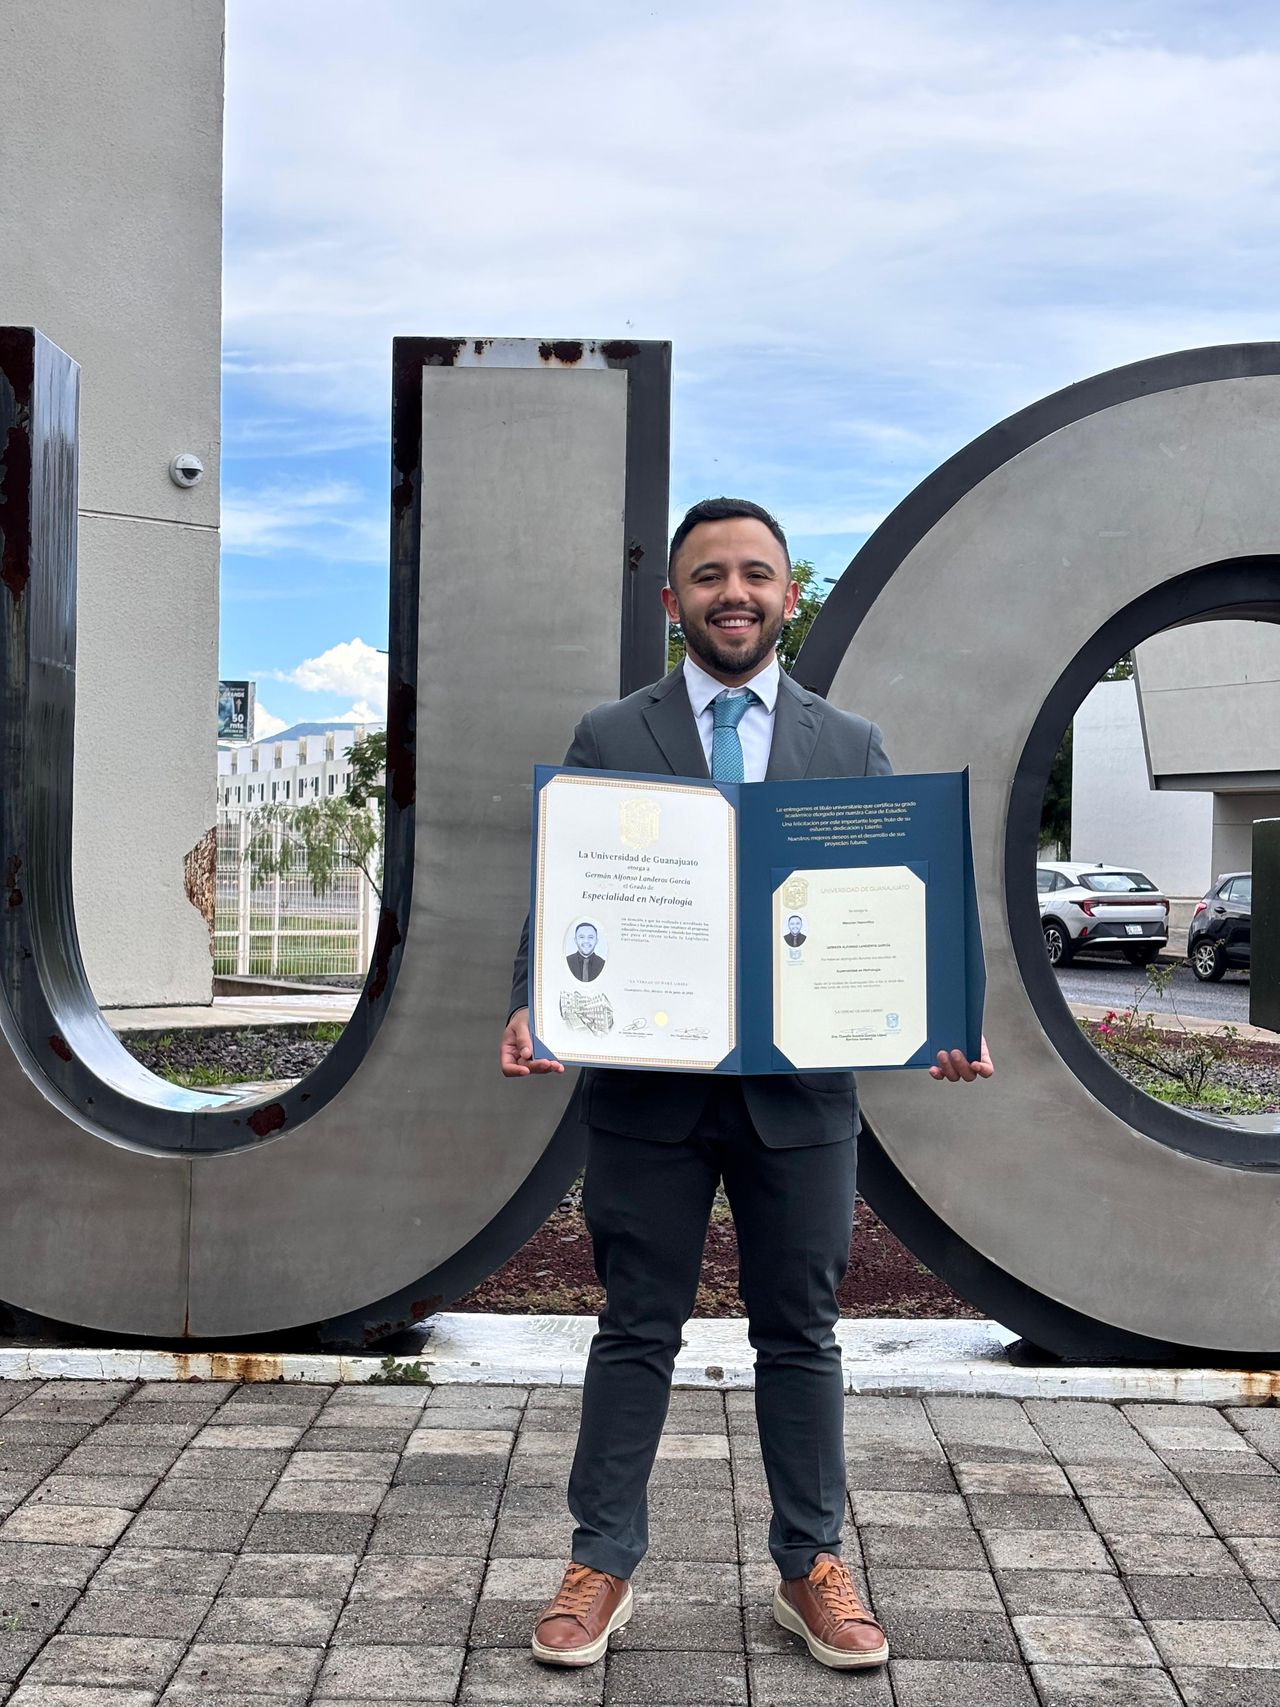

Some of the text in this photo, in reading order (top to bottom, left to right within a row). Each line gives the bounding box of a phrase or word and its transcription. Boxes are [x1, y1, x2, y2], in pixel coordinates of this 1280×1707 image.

[232, 714, 244, 722] 50
[578, 850, 588, 858] La
[591, 852, 639, 862] Universidad
[653, 856, 698, 866] Guanajuato
[613, 873, 638, 881] Alfonso
[638, 875, 668, 883] Landeros
[582, 891, 635, 902] Especialidad
[648, 895, 693, 908] Nefrología
